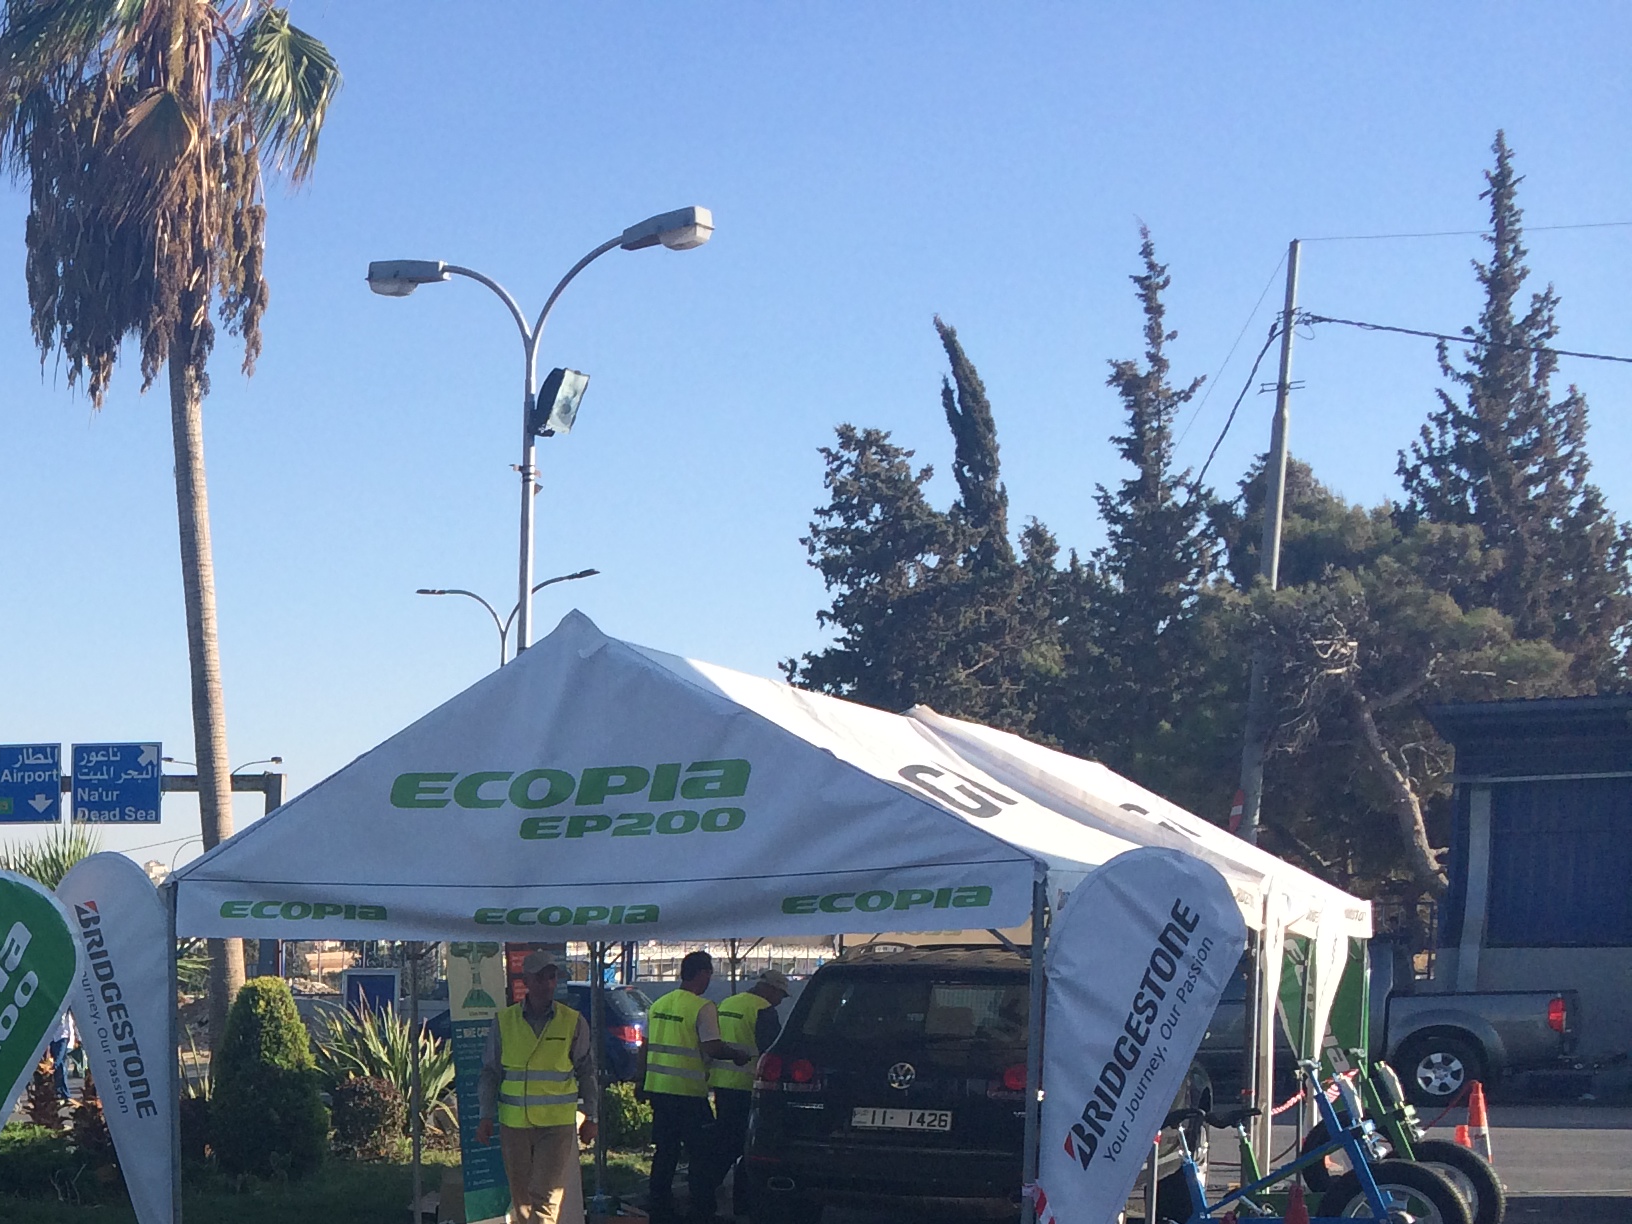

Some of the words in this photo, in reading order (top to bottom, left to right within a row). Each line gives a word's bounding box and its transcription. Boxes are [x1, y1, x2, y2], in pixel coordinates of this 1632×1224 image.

[14, 747, 58, 768] المطار
[78, 747, 121, 766] ناعور
[0, 768, 59, 785] Airport
[77, 766, 114, 784] الميت
[117, 765, 158, 784] البحر
[77, 787, 120, 802] Na'ur
[77, 807, 120, 821] Dead
[124, 806, 157, 821] Sea
[519, 807, 747, 841] EP200
[74, 900, 158, 1119] BRIDGESTONE
[1064, 897, 1201, 1172] BRIDGESTONE
[1103, 1117, 1131, 1163] Your
[1126, 1044, 1169, 1123] Journey,
[1160, 1003, 1181, 1039] Our
[1176, 936, 1214, 1005] Passion
[97, 1027, 112, 1055] Our
[106, 1059, 129, 1114] Passion
